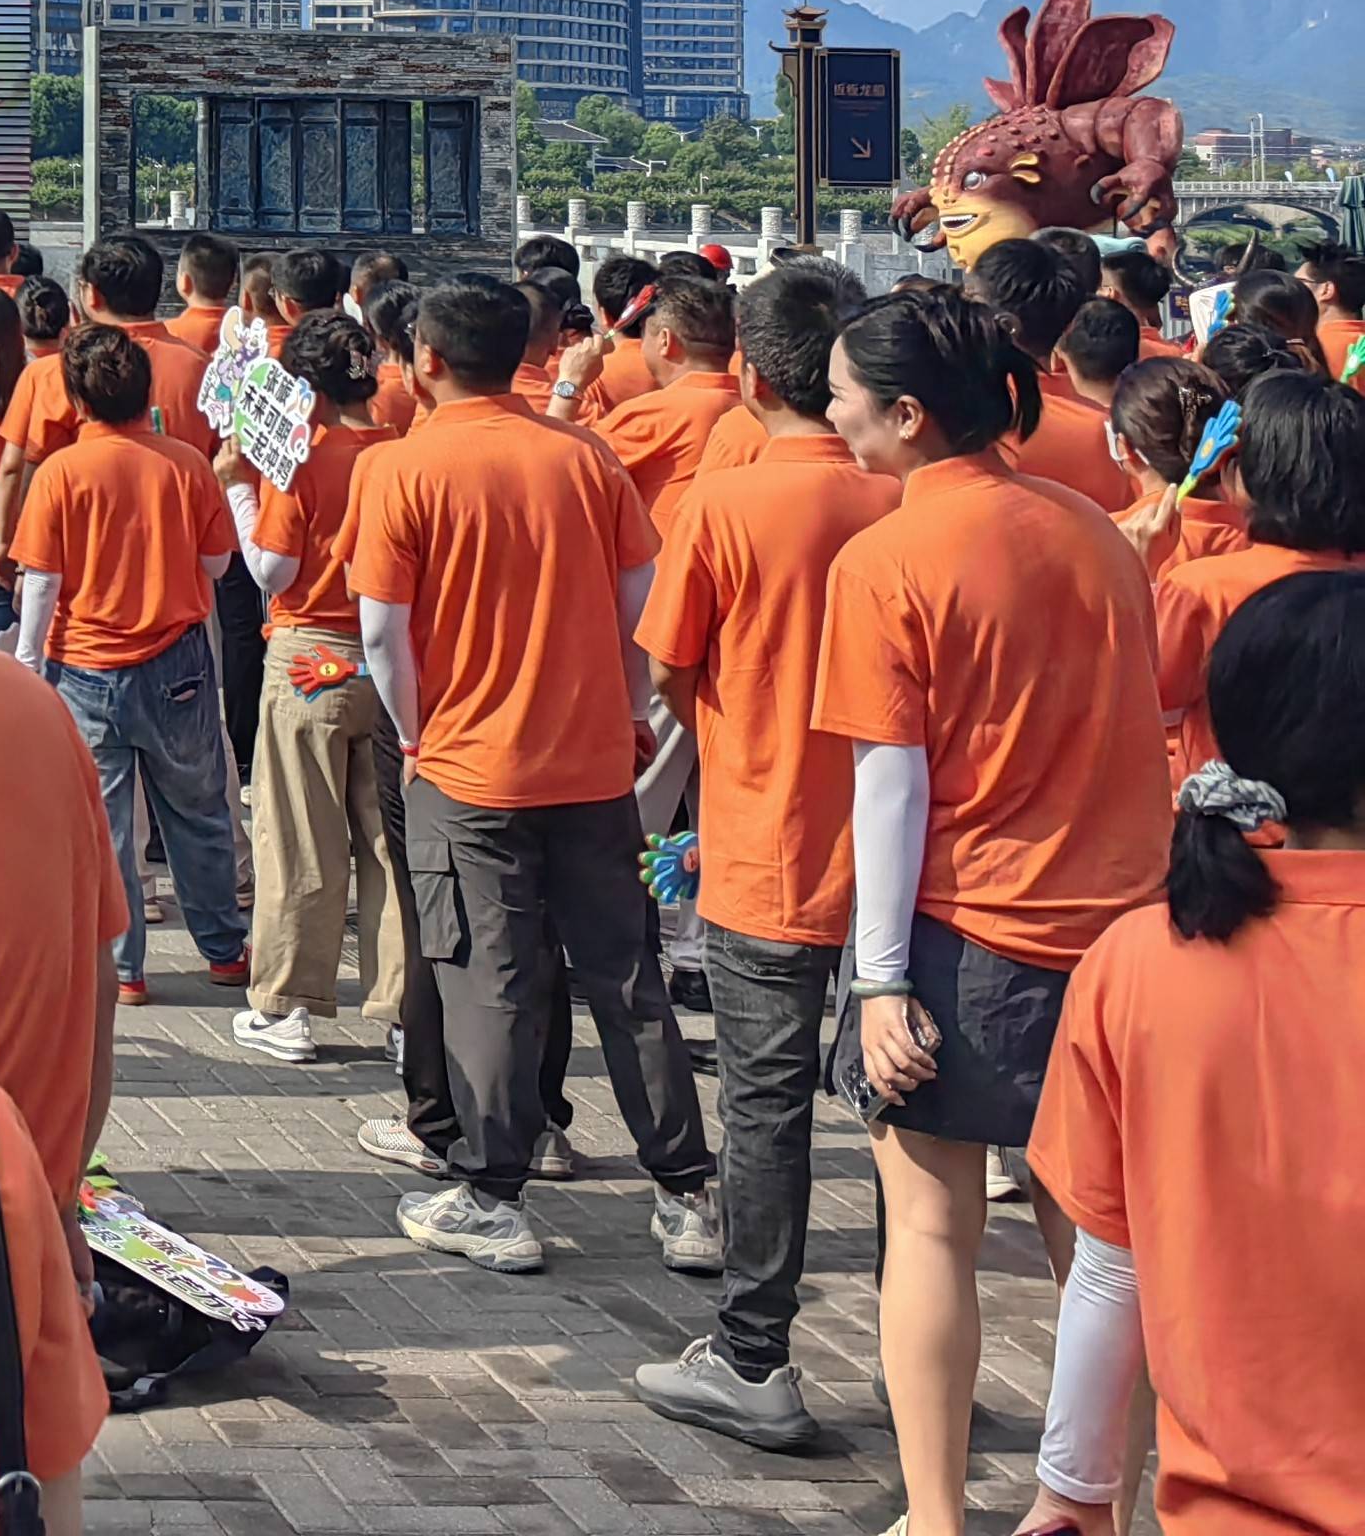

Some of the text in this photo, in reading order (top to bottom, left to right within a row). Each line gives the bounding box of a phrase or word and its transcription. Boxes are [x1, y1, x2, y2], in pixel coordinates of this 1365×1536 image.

[263, 364, 295, 406] 张旅
[243, 427, 294, 487] 一起冲鸭
[126, 1224, 188, 1257] 张旅
[138, 1259, 266, 1331] 光芒万丈
